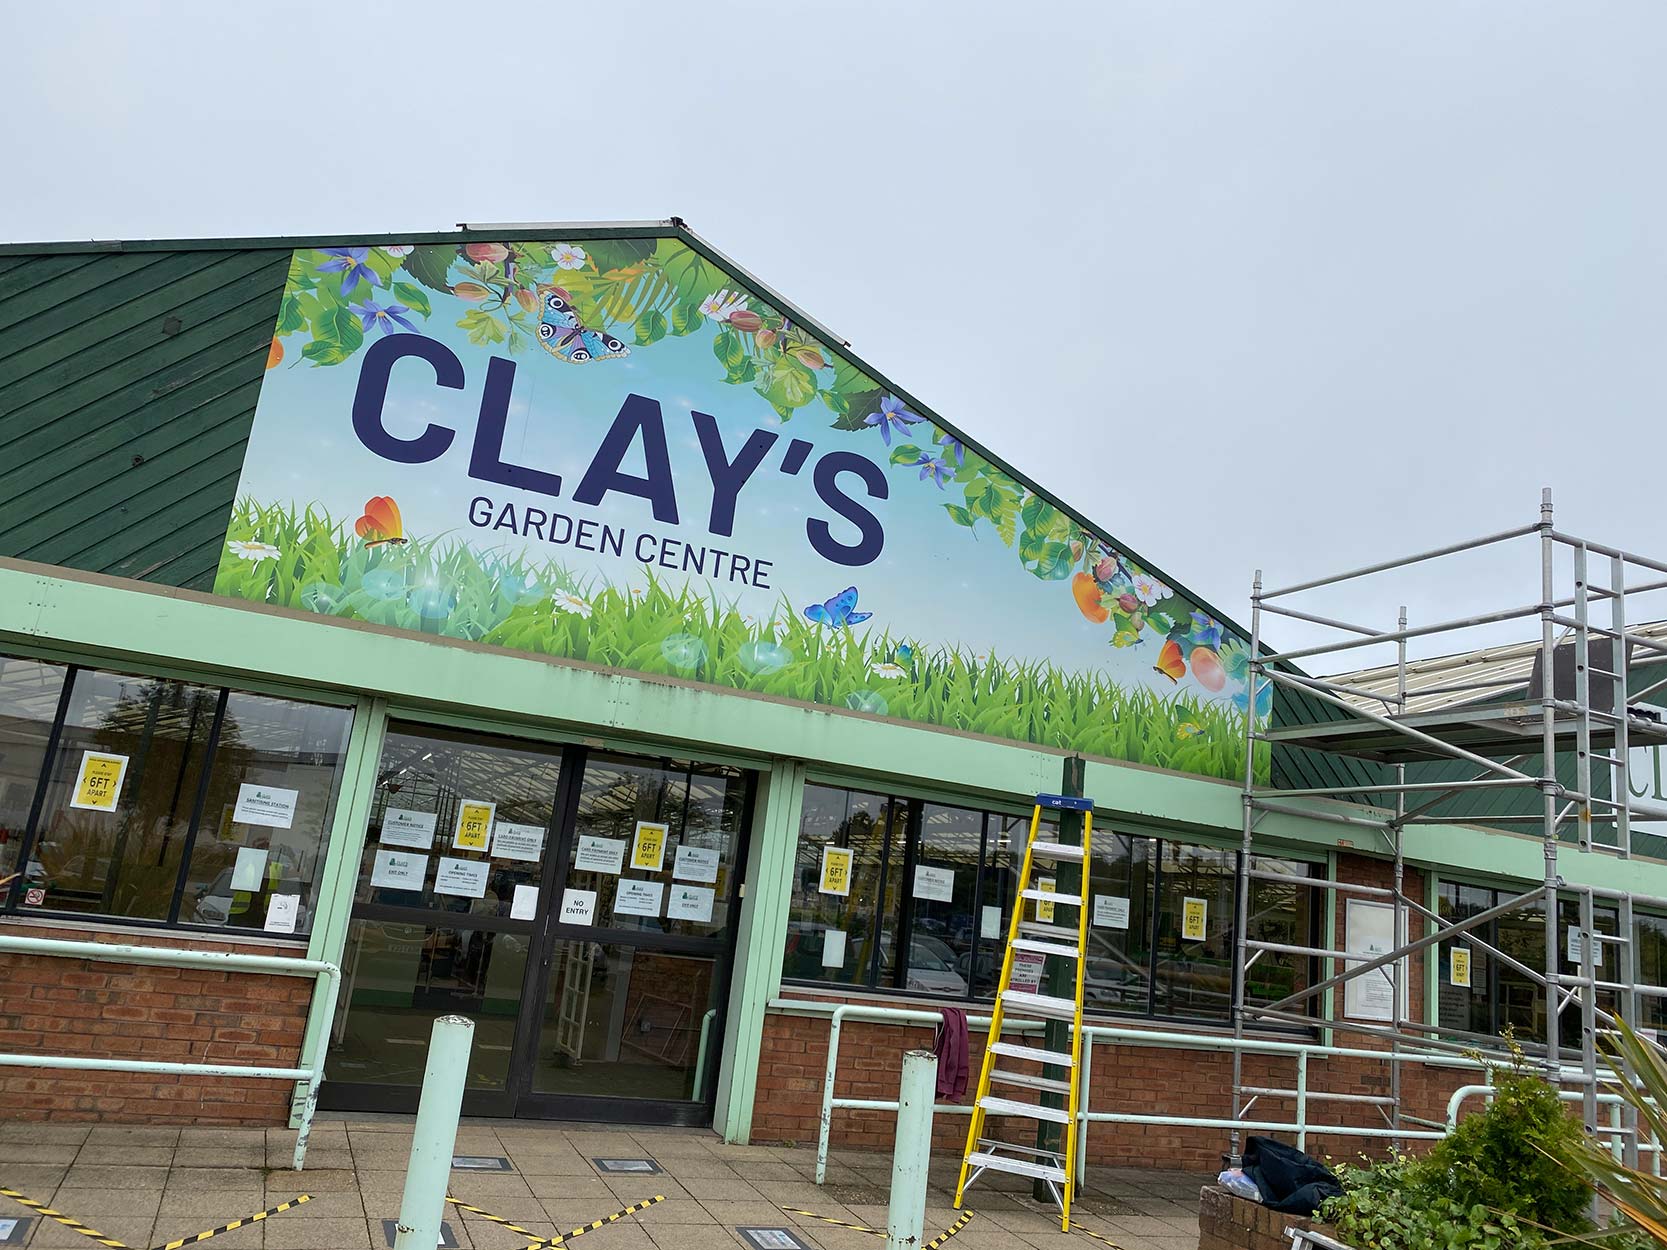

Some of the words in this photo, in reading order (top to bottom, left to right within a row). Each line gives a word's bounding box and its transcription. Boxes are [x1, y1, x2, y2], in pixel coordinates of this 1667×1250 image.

[352, 333, 889, 567] CLAY'S
[468, 496, 625, 557] GARDEN
[633, 533, 774, 590] CENTRE
[89, 776, 110, 790] 6FT
[87, 789, 107, 797] APART
[466, 821, 482, 832] 6FT
[642, 842, 656, 852] 6FT
[830, 867, 843, 877] 6FT
[566, 907, 589, 915] ENTRY
[1189, 915, 1199, 924] 6FT
[1456, 963, 1465, 972] 6FT
